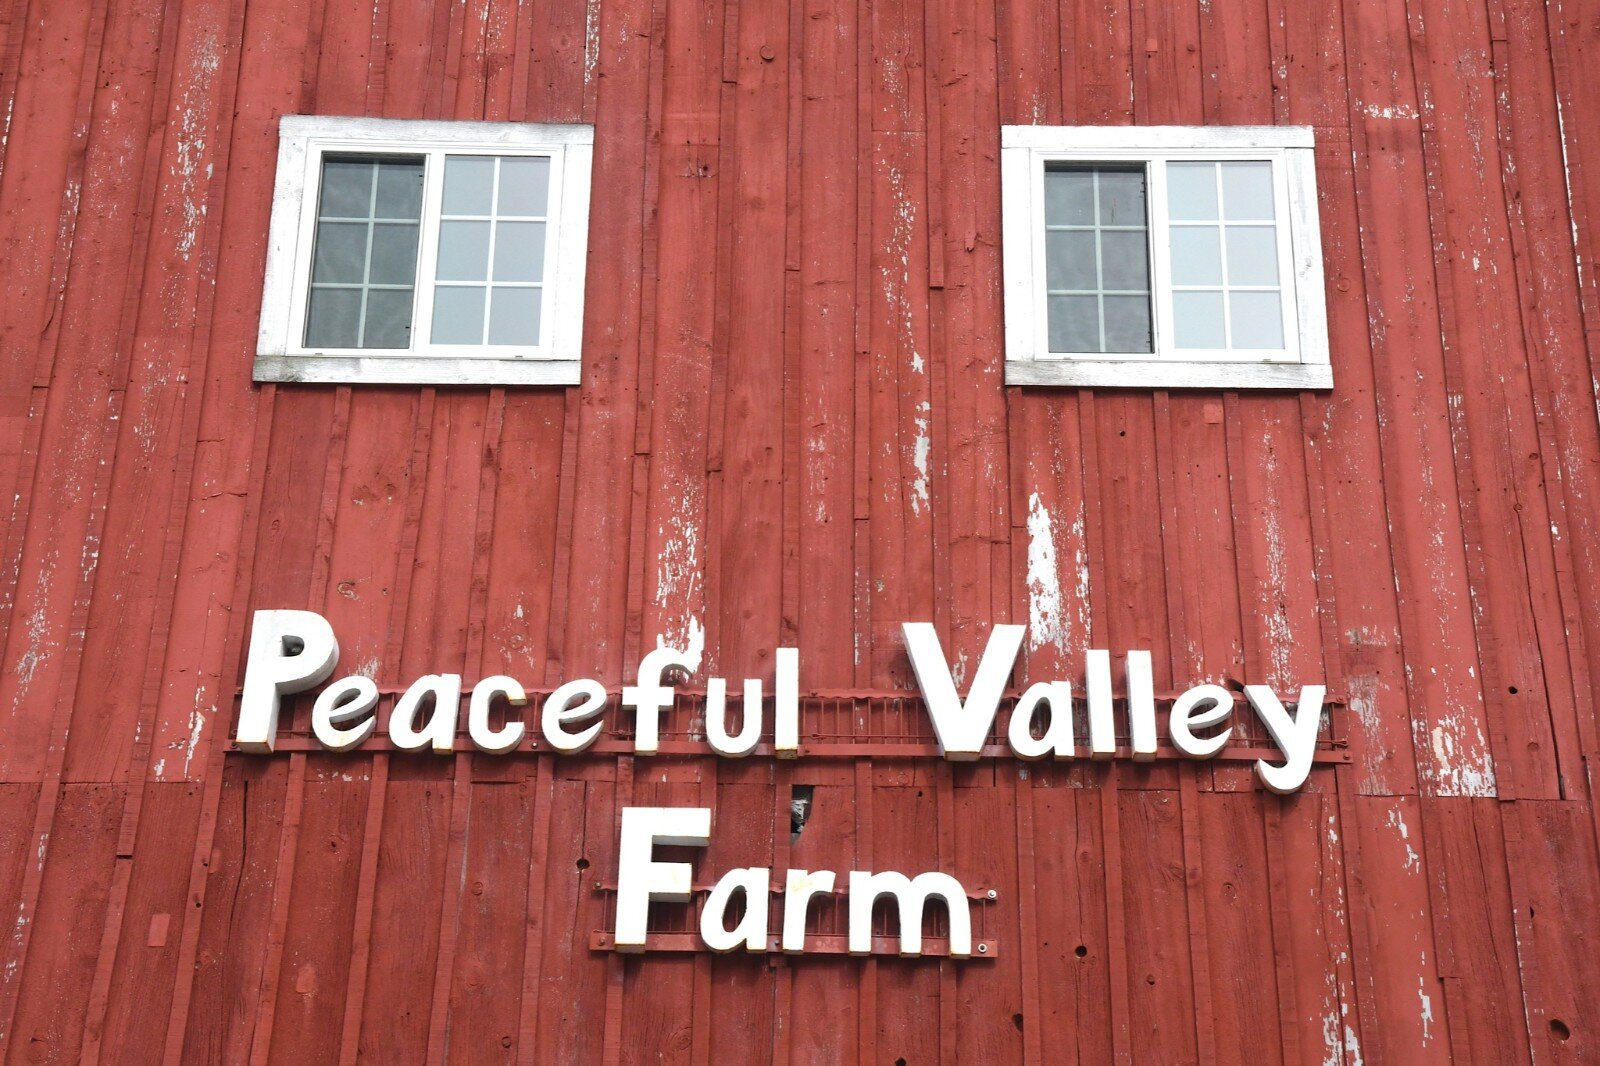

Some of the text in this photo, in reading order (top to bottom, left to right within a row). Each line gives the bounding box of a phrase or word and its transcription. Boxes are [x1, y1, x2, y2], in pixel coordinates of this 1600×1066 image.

[236, 609, 1326, 794] Peaceful Valley
[614, 806, 972, 957] Farm
